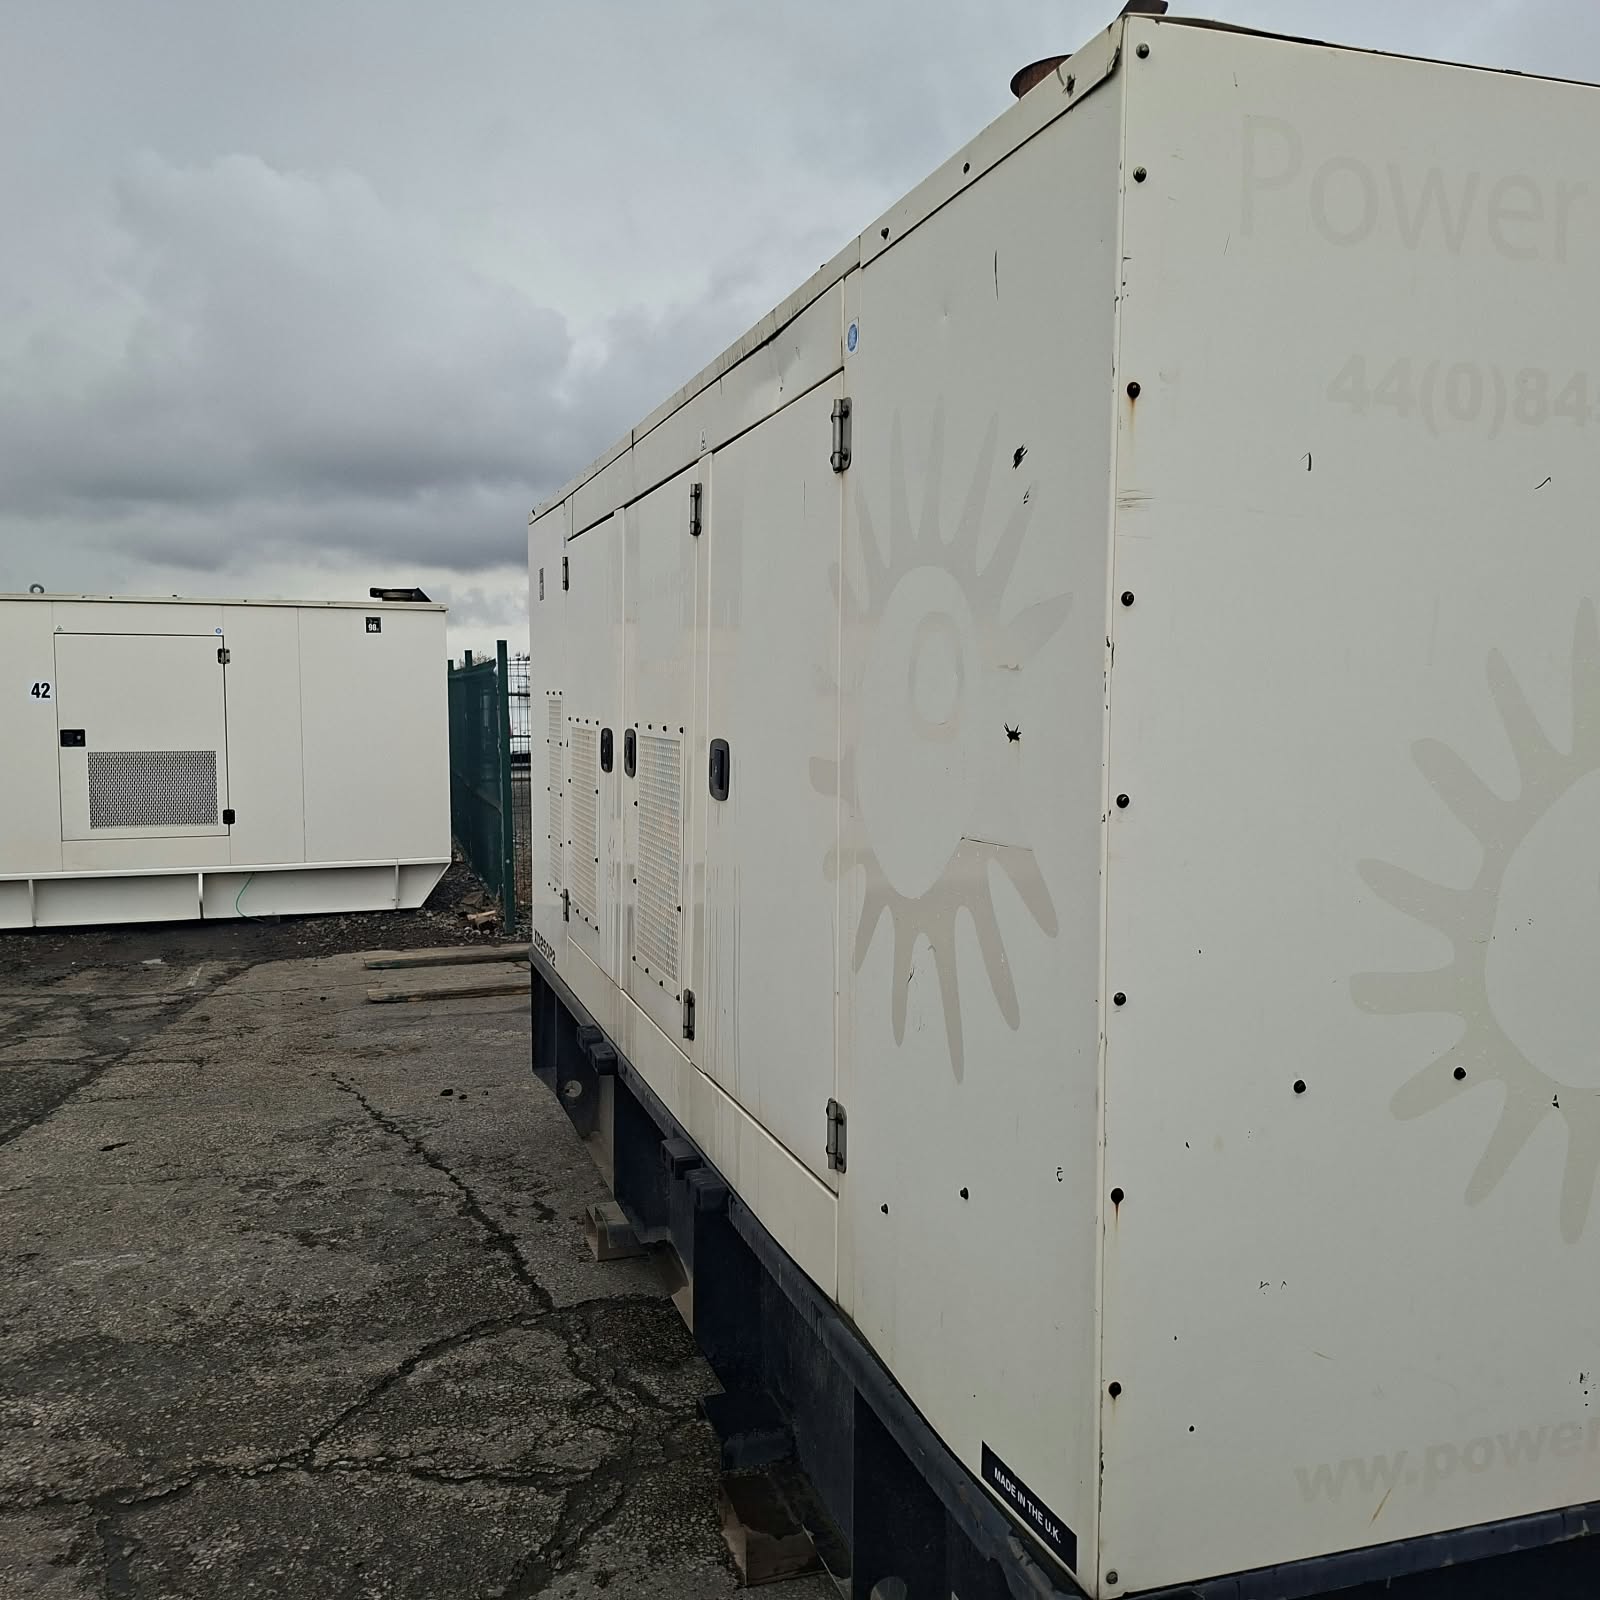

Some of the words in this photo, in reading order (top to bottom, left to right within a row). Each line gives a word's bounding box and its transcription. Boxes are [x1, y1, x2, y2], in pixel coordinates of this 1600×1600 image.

[1325, 353, 1600, 442] 44(0)84
[30, 682, 51, 699] 42
[994, 1467, 1017, 1498] MADE
[1017, 1490, 1026, 1508] IN
[1027, 1500, 1044, 1526] THE
[1045, 1518, 1061, 1544] U.K.
